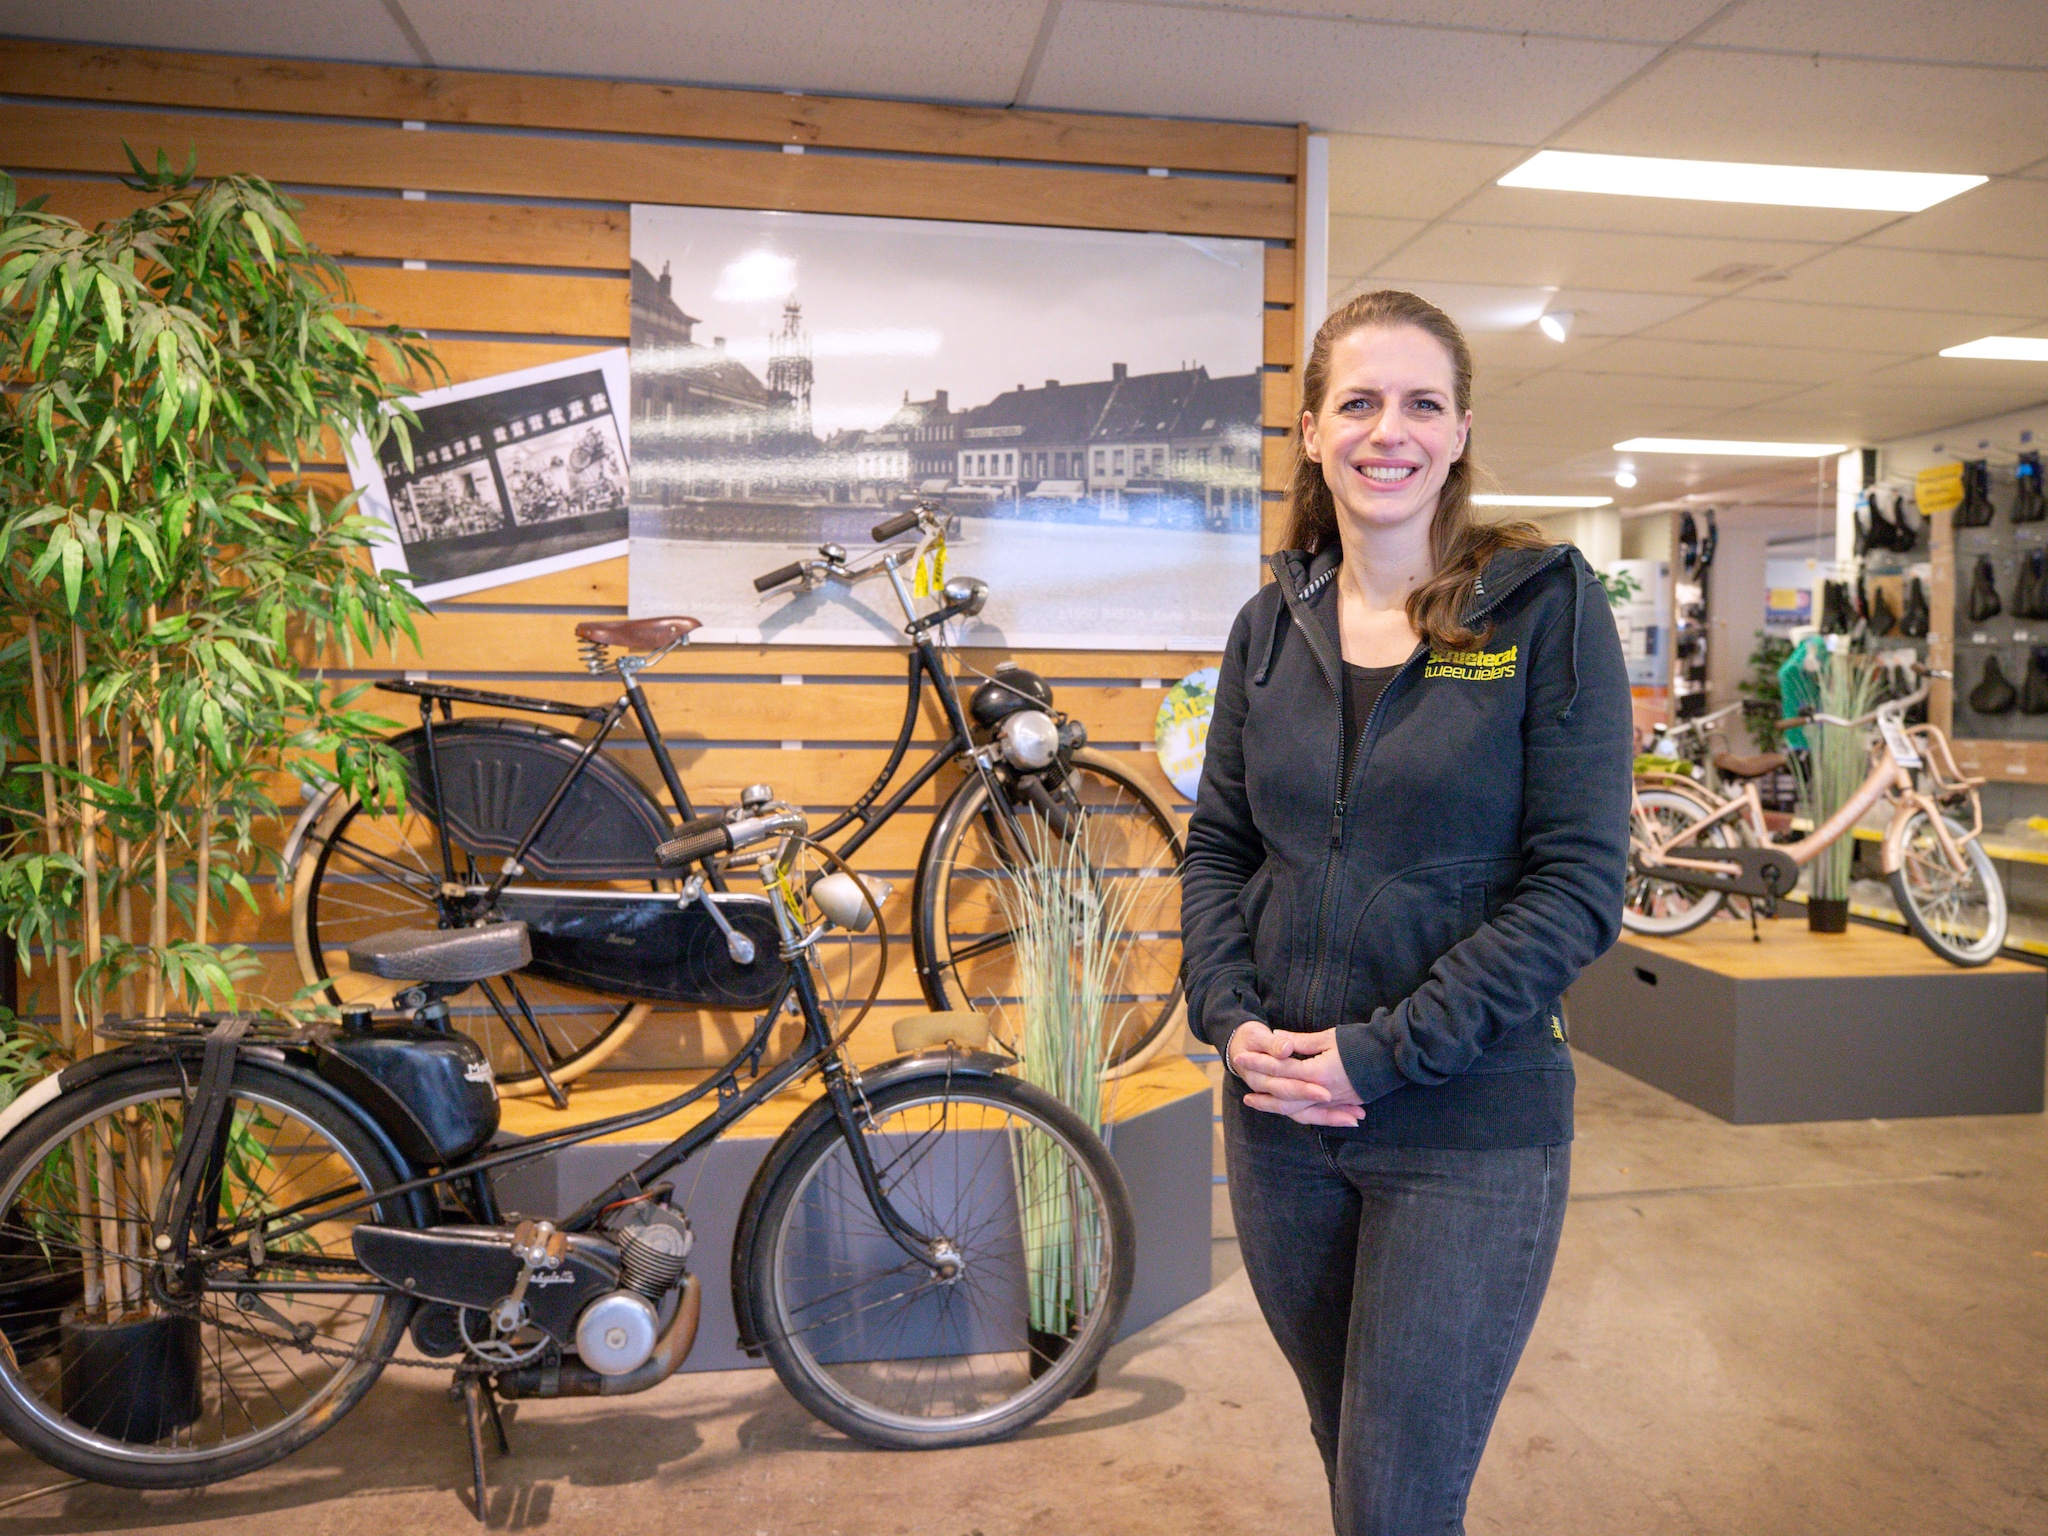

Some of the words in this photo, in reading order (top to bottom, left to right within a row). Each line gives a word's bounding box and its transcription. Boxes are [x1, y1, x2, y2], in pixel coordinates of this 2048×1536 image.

[1424, 665, 1517, 681] tweewielers
[1174, 696, 1206, 725] AL
[1187, 722, 1208, 749] JA
